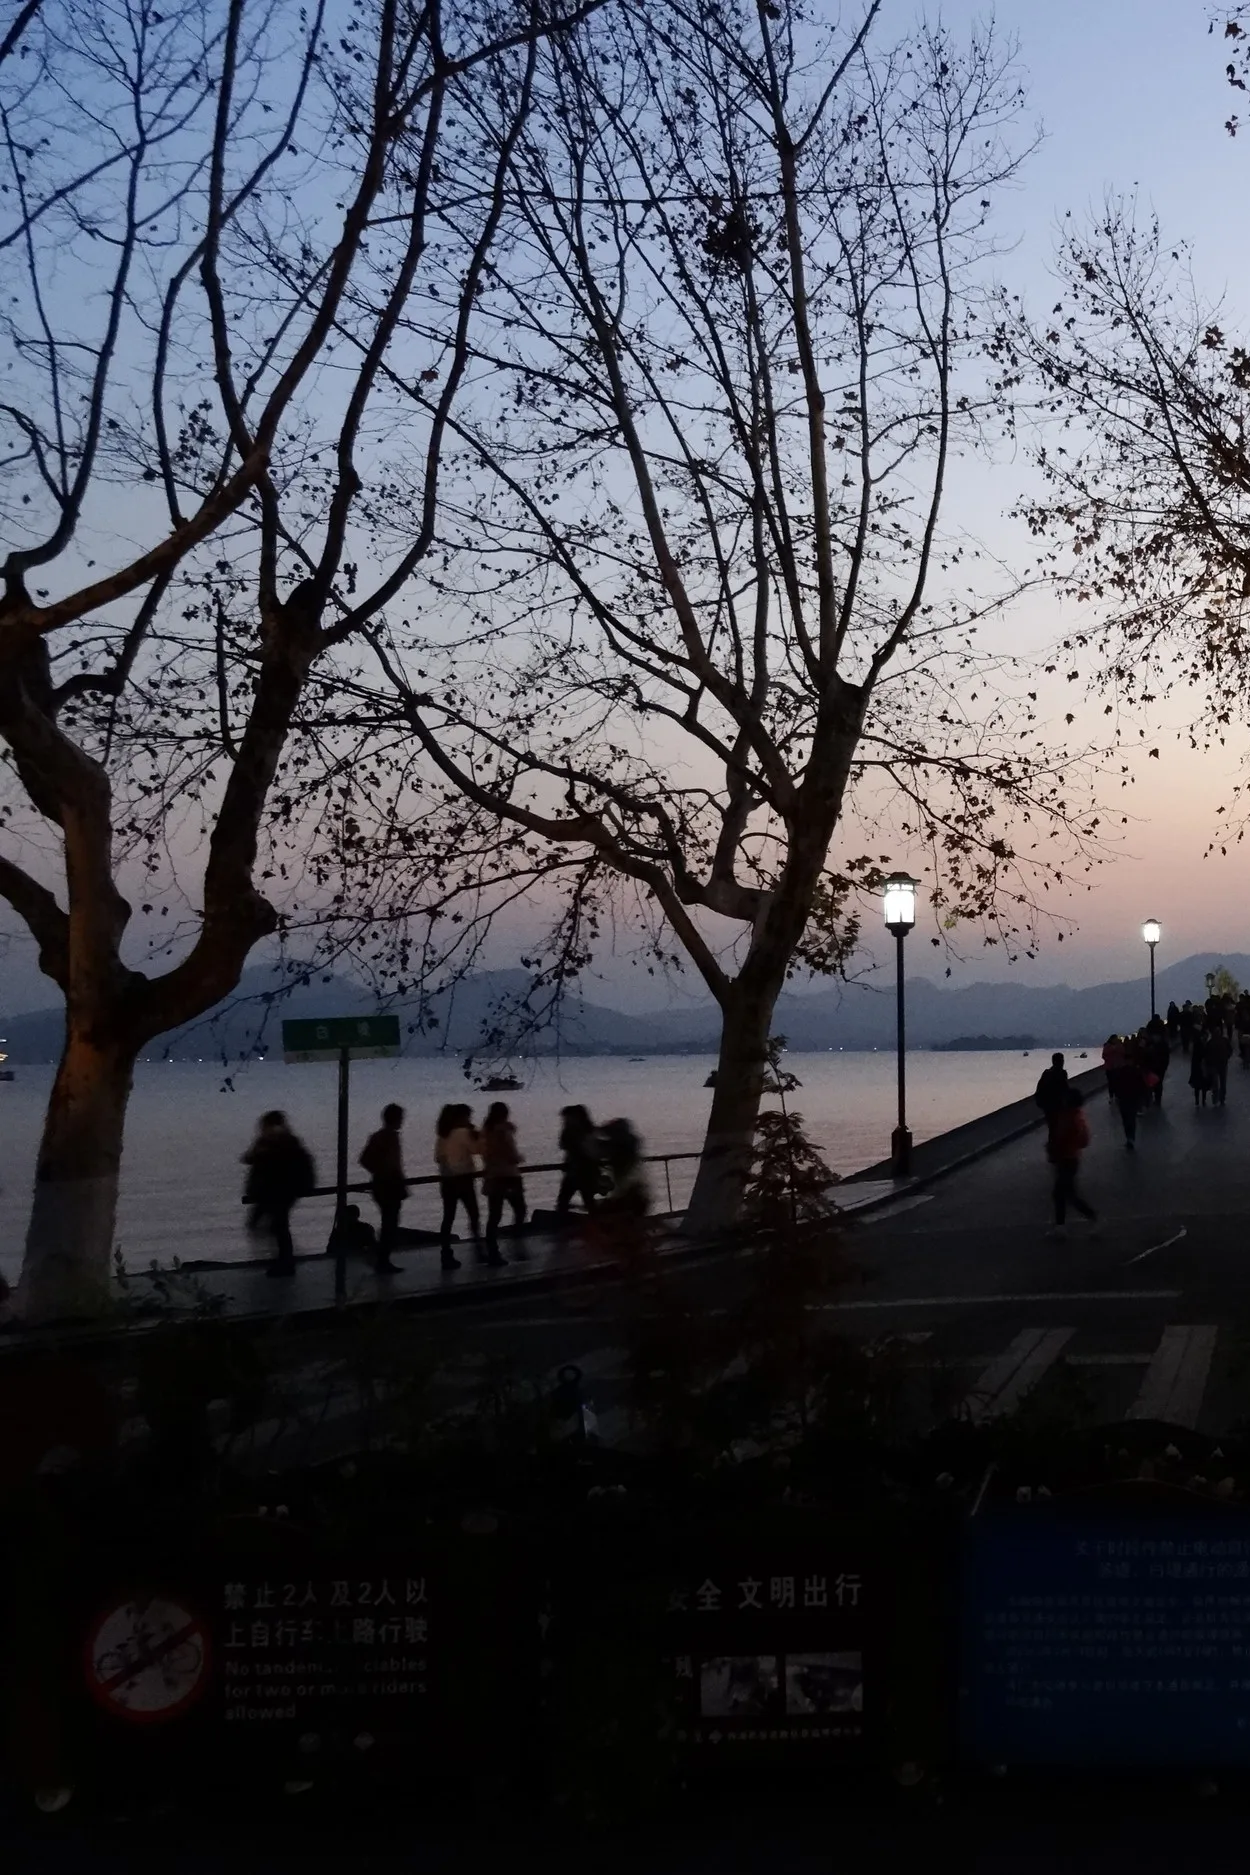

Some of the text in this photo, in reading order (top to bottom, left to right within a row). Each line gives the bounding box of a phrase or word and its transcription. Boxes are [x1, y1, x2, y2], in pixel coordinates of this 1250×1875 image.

[736, 1572, 862, 1610] 文明出行
[224, 1660, 250, 1676] No
[224, 1683, 250, 1698] for
[256, 1683, 290, 1697] two
[297, 1684, 314, 1696] or
[372, 1679, 428, 1695] riders
[224, 1703, 296, 1720] allowed
